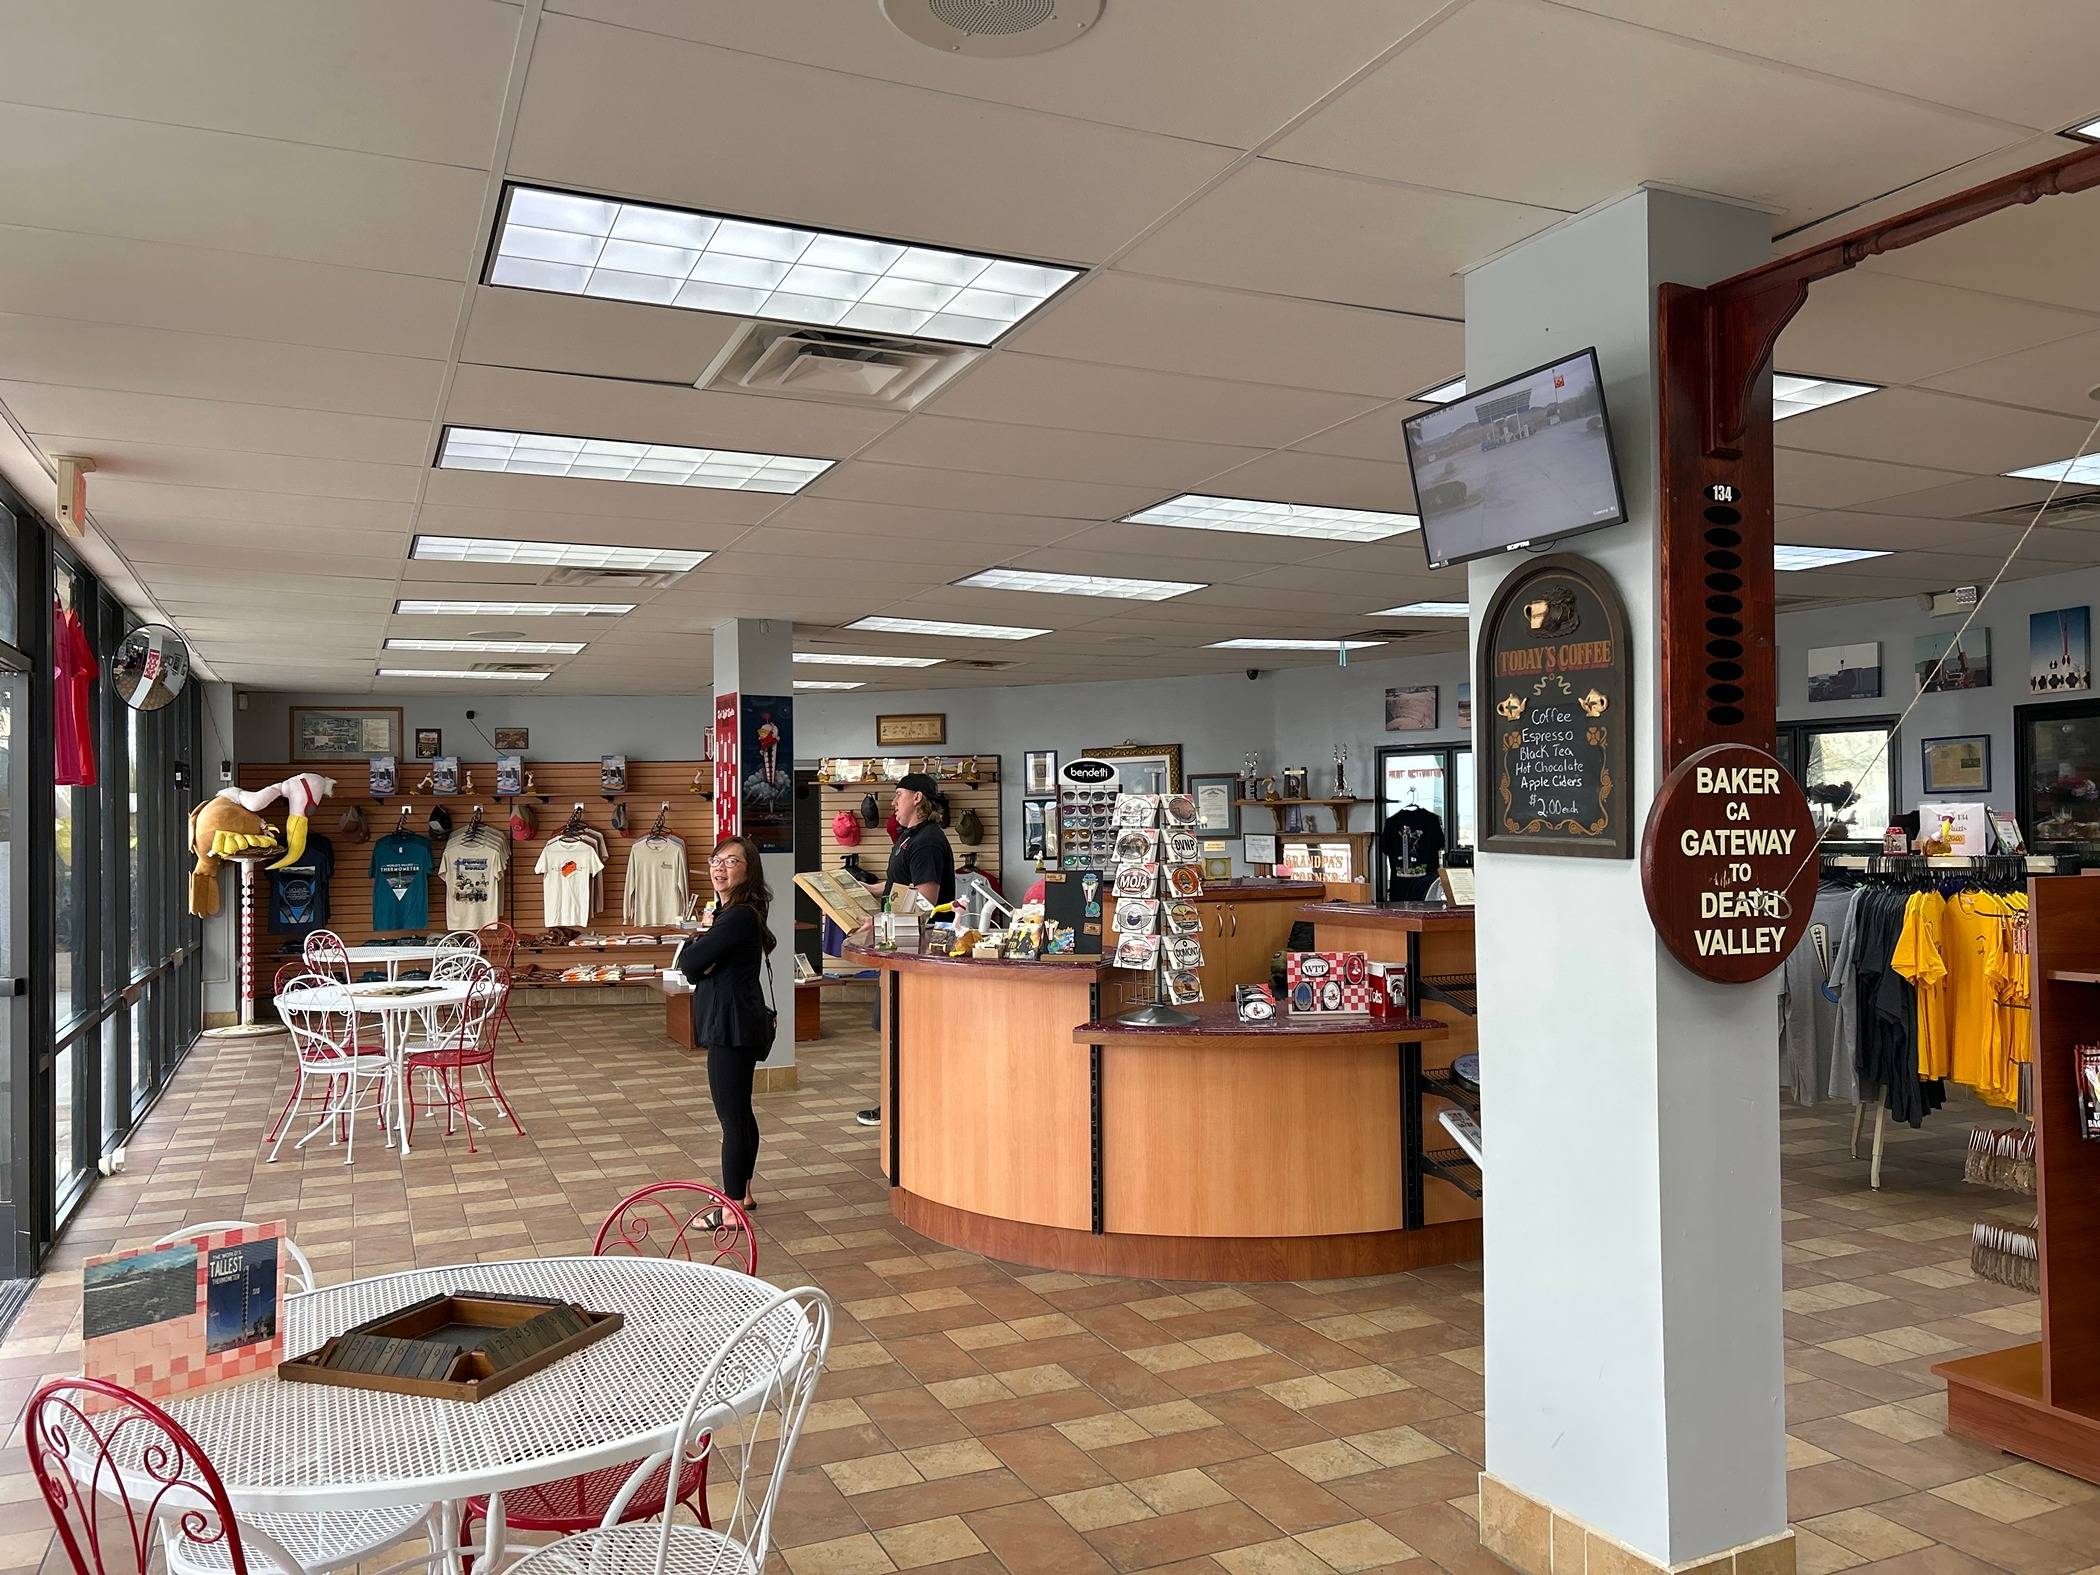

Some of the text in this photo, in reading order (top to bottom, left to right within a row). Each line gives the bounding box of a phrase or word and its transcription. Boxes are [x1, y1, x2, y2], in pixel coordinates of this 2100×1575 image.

[1712, 484, 1732, 502] 134
[1499, 640, 1612, 674] TODAY'S COFFEE
[1531, 707, 1572, 725] Coffee
[1521, 728, 1574, 745] Espresso
[1519, 743, 1575, 761] Black Tea
[1515, 758, 1584, 776] Hot Chocolate
[1520, 774, 1583, 791] Apple Ciders
[1696, 767, 1780, 795] BAKER
[1726, 802, 1751, 821] CA
[1174, 839, 1195, 851] DVNP
[1681, 829, 1796, 856] GATEWAY
[1729, 863, 1752, 882] TO
[1701, 889, 1779, 919] DEATH
[1694, 926, 1786, 956] VALLEY
[1304, 965, 1326, 973] WTT
[209, 1256, 244, 1278] TALLEST
